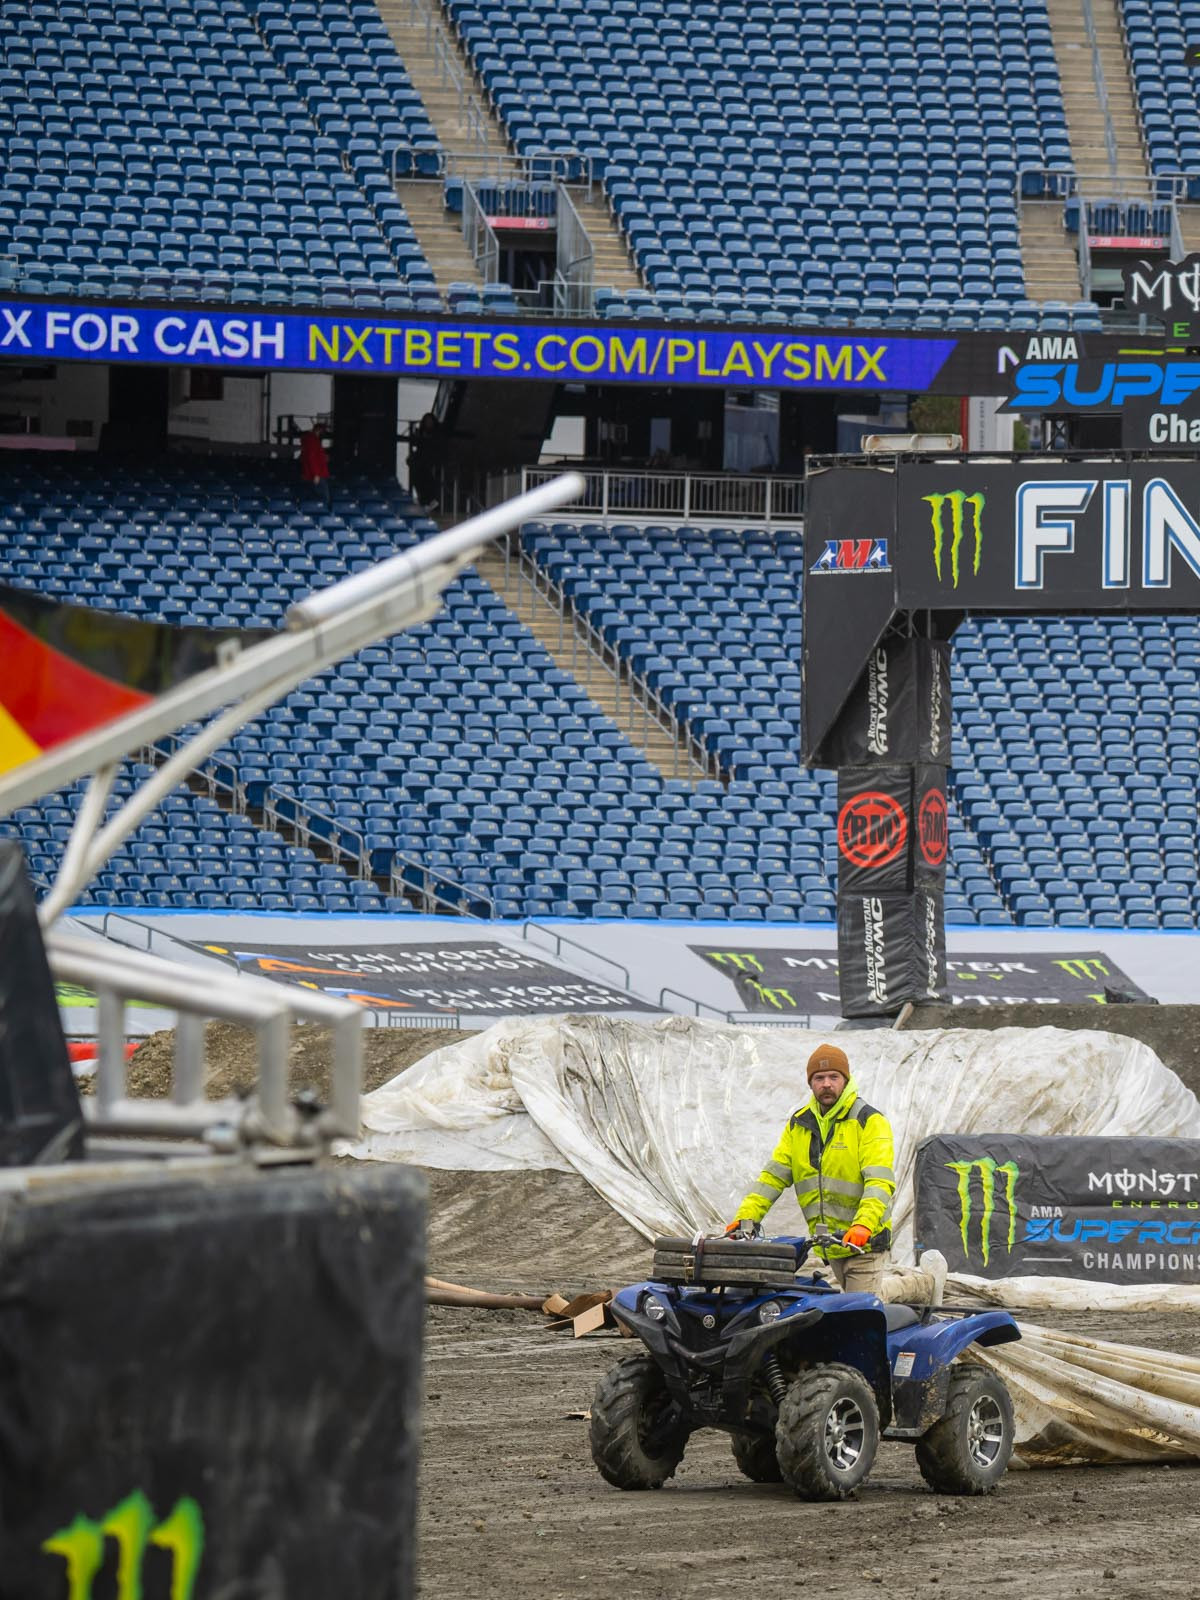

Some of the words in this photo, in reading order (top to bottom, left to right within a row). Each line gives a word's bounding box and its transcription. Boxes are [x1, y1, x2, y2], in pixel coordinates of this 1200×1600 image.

[45, 311, 141, 354] FOR
[153, 317, 285, 360] CASH
[308, 323, 888, 382] NXTBETS.COM/PLAYSMX
[1025, 337, 1079, 360] AMA
[809, 537, 893, 571] AMA
[867, 705, 878, 739] ROCKY
[862, 897, 874, 954] MOUNTAIN
[307, 952, 396, 963] UTAH
[399, 948, 521, 962] SPORTS
[336, 959, 547, 973] COMMISSION
[866, 955, 876, 988] ROCKY
[1030, 1206, 1063, 1218] AMA
